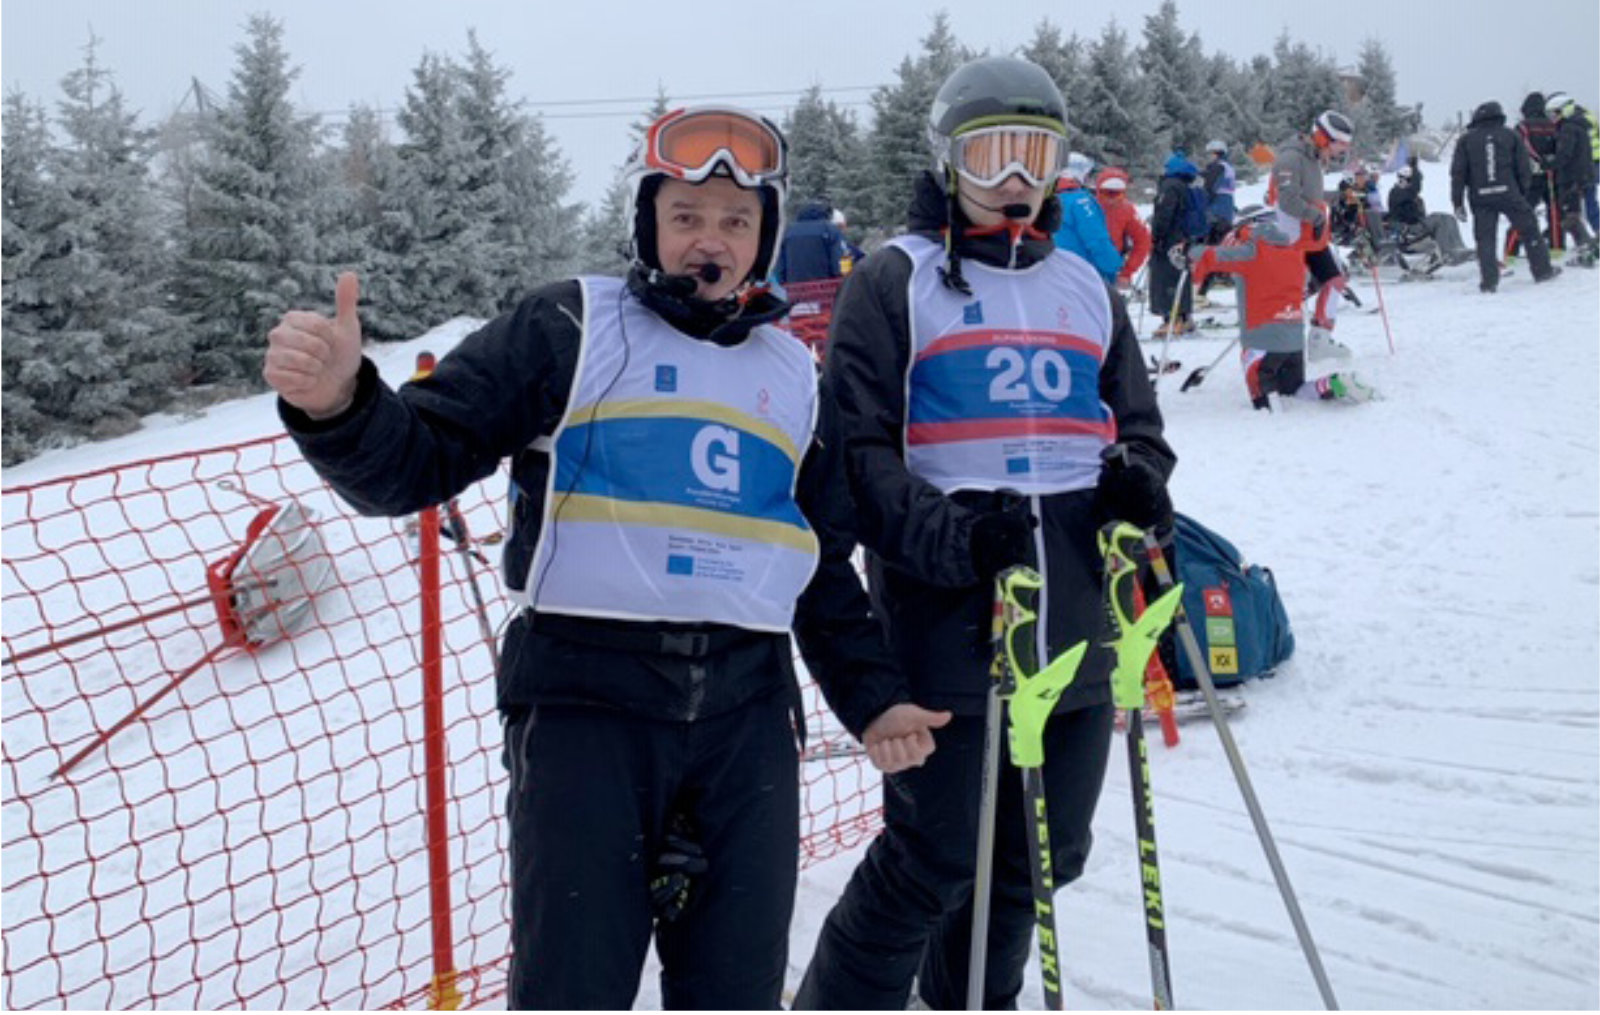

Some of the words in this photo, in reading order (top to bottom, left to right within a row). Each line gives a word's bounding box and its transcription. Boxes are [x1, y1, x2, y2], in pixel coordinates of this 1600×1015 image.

[985, 346, 1071, 402] 20
[691, 425, 740, 491] G
[1138, 838, 1164, 930] LEKI
[1035, 898, 1060, 993] LEKI
